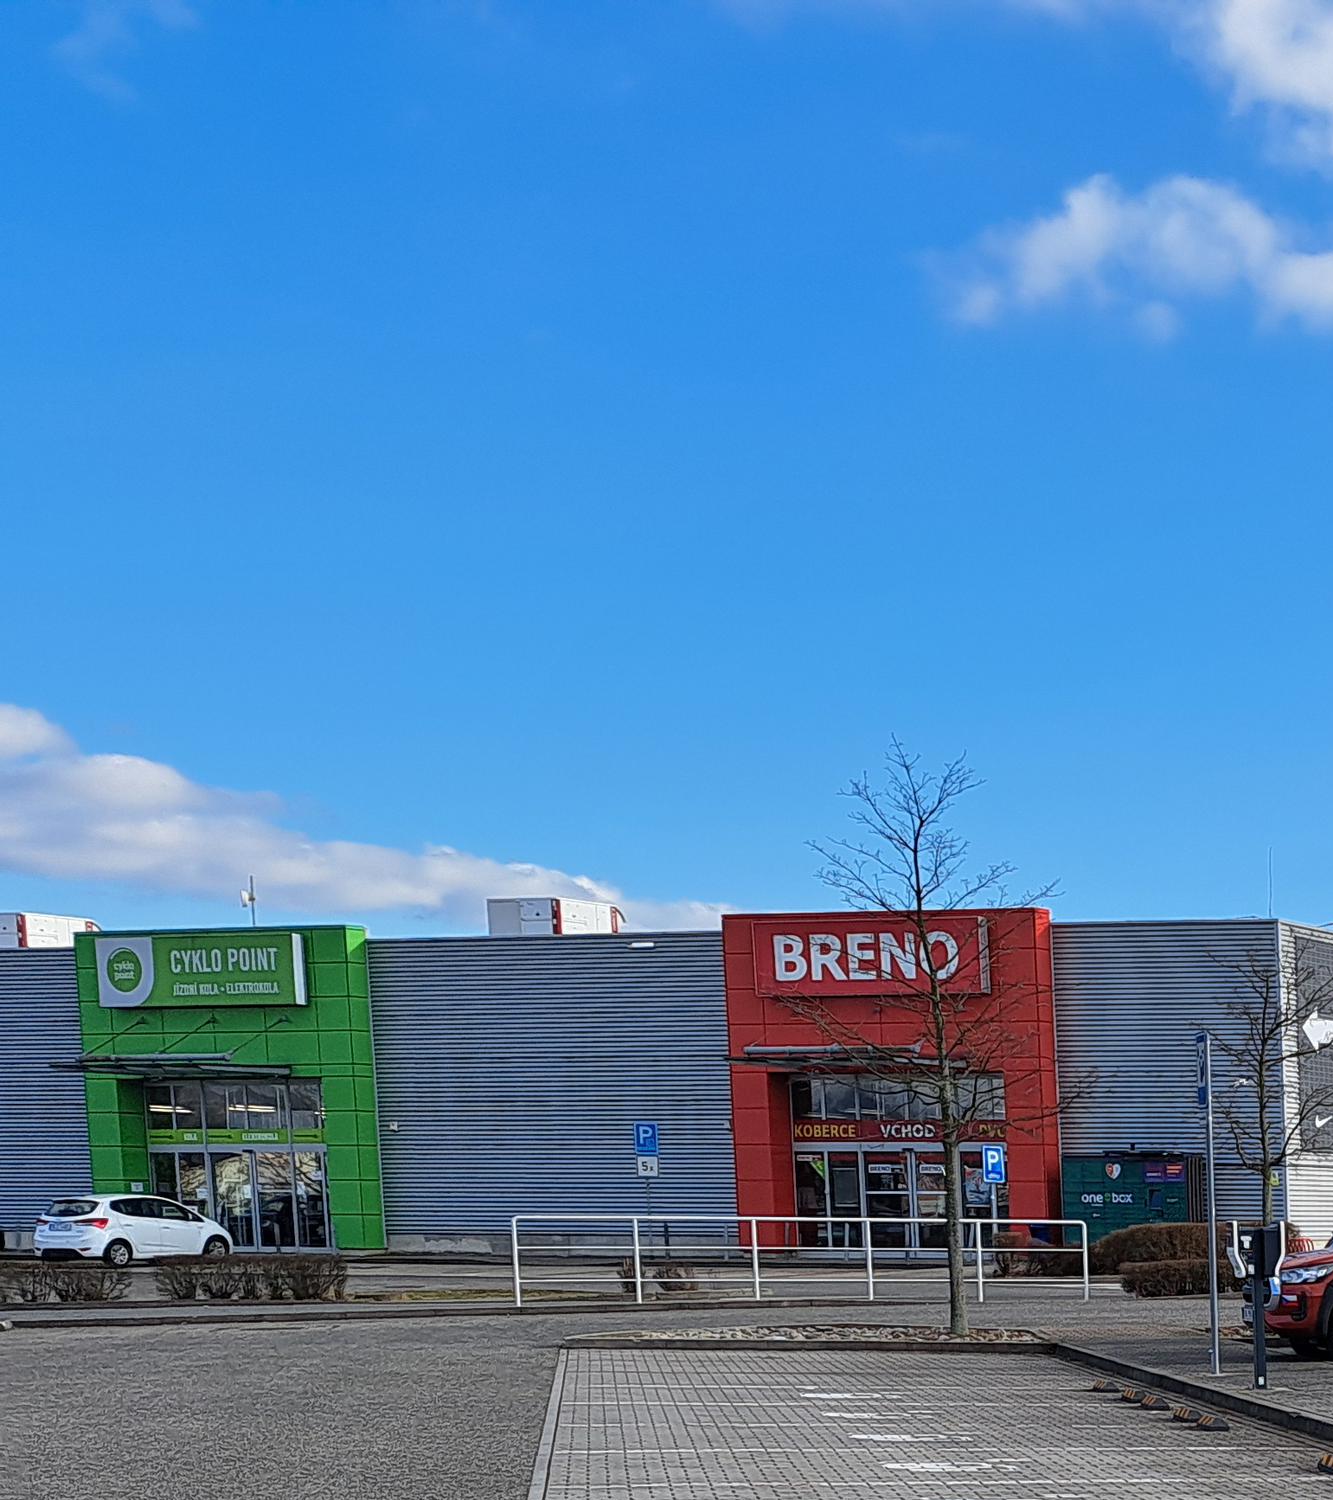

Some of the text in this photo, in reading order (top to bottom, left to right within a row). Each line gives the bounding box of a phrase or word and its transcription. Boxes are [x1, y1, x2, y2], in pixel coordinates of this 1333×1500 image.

[170, 948, 277, 973] CYKLO POINT
[772, 930, 960, 981] BRENO
[199, 983, 219, 994] KOLA
[226, 982, 279, 994] ELEKTROKOLA
[639, 1126, 653, 1145] P
[795, 1125, 856, 1138] KOBERCE
[881, 1124, 936, 1138] VCHOD
[988, 1151, 998, 1171] P
[1081, 1193, 1104, 1203] one
